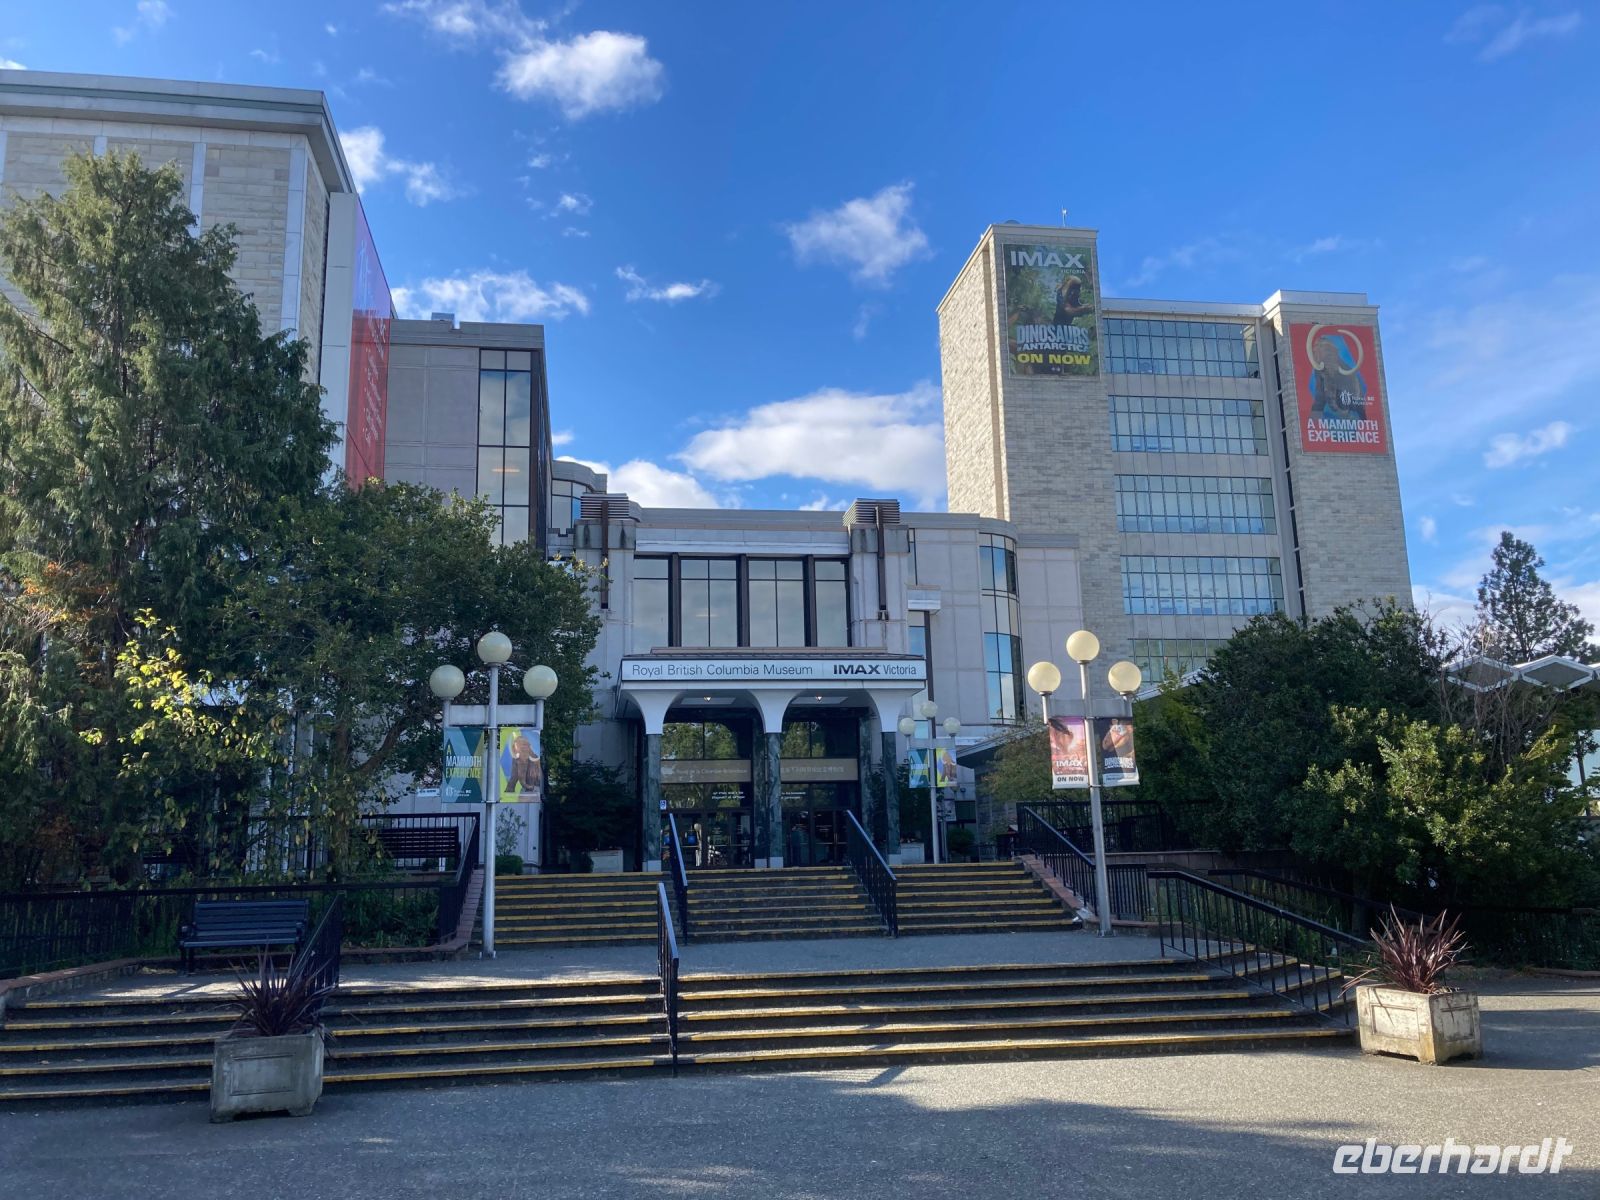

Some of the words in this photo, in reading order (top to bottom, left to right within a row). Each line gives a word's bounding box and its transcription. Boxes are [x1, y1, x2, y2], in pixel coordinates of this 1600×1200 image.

[1010, 250, 1085, 269] IMAX
[1016, 324, 1089, 346] DINOSAURS
[1017, 353, 1043, 364] ON
[1048, 354, 1091, 365] NOW
[1307, 418, 1315, 429] A
[1318, 419, 1378, 431] MAMMOTH
[1308, 430, 1380, 444] EXPERIENCE
[632, 664, 663, 676] Royal
[667, 664, 703, 676] British
[707, 664, 759, 676] Columbia
[763, 664, 813, 676] Museum
[833, 664, 881, 675] IMAX
[882, 664, 917, 676] Victoria
[446, 756, 482, 767] MAMMOTH
[1056, 758, 1083, 768] IMAX
[446, 767, 481, 779] EXPERIENCE
